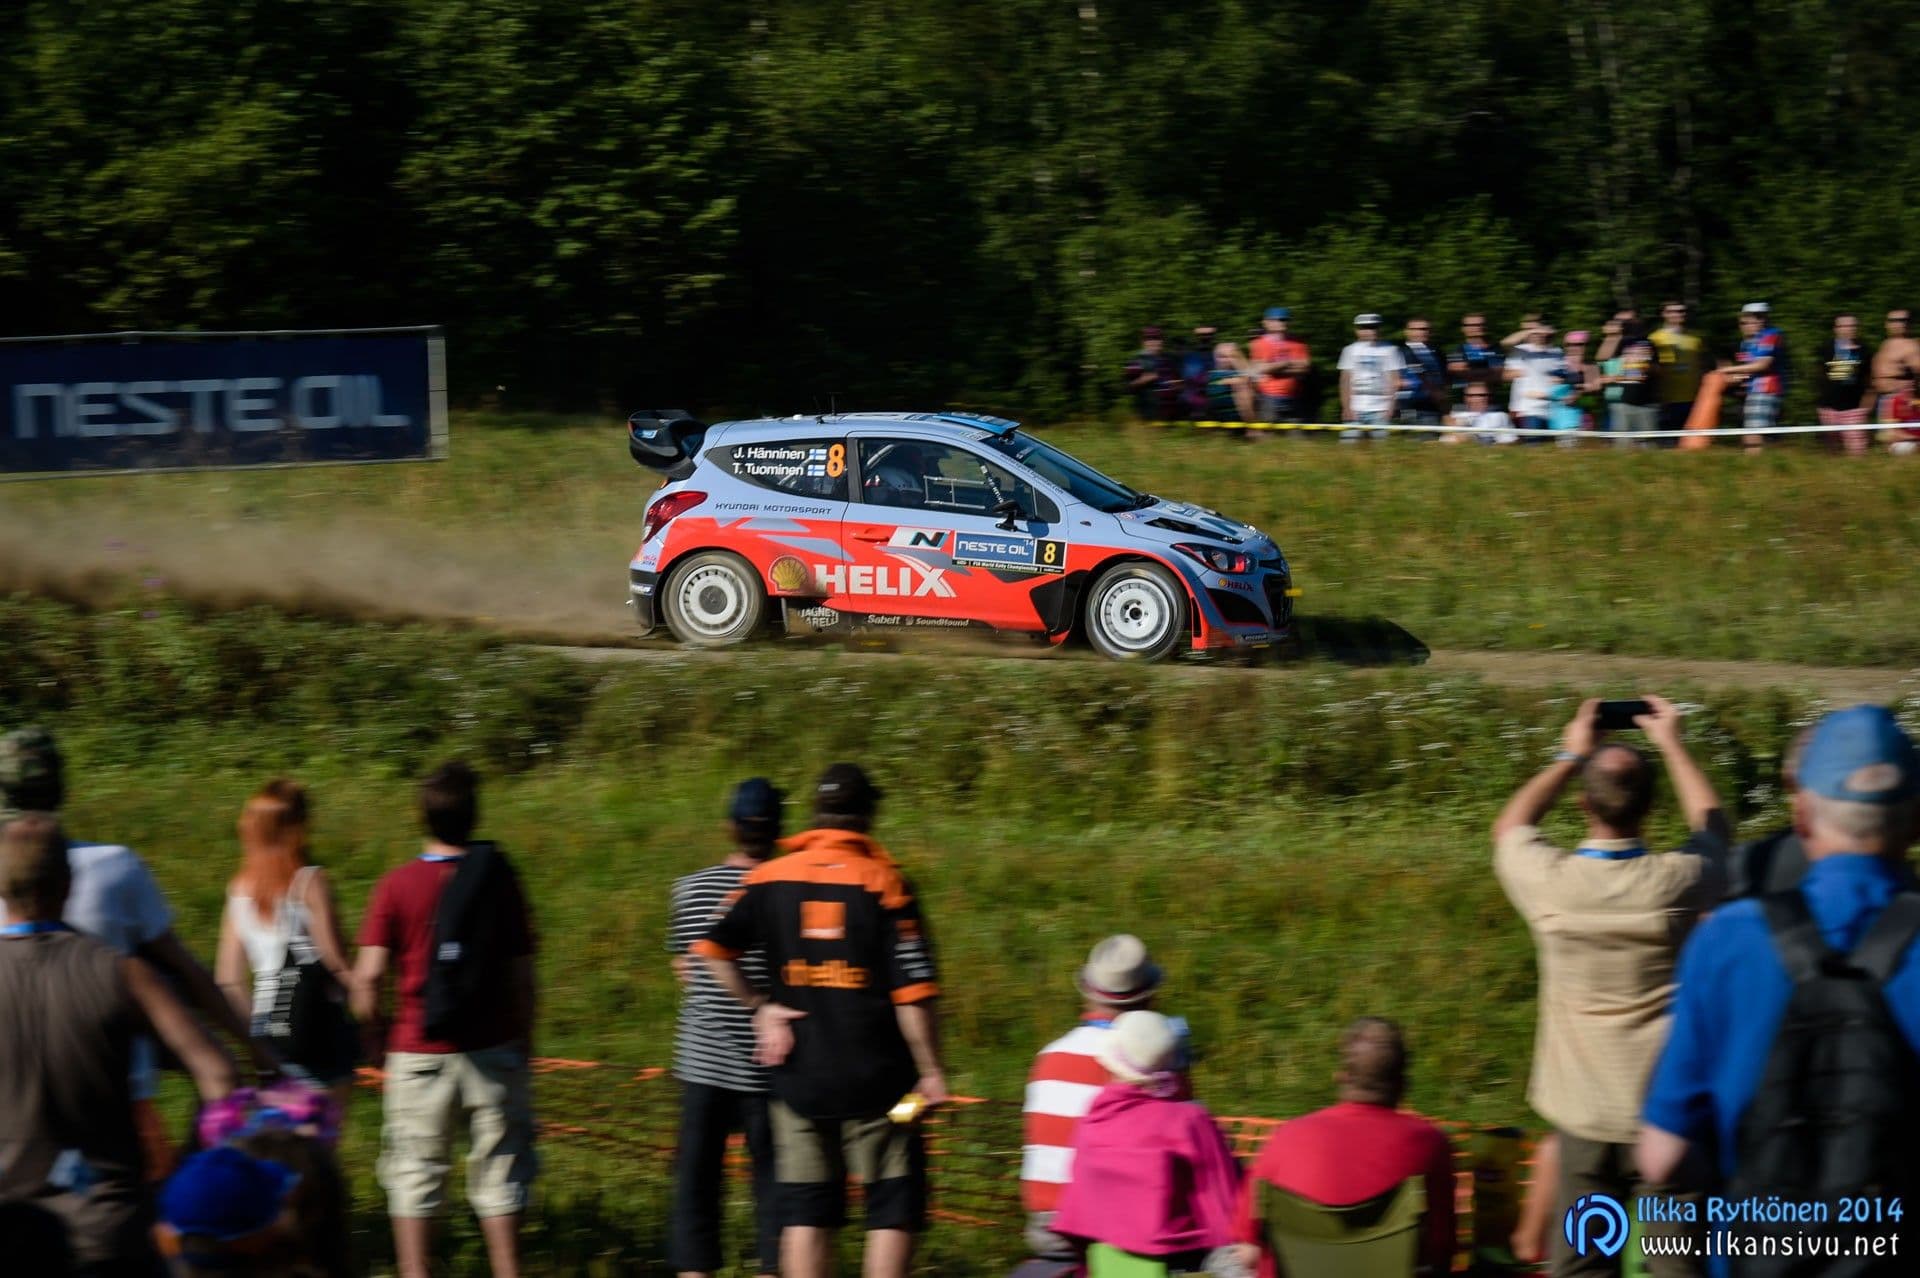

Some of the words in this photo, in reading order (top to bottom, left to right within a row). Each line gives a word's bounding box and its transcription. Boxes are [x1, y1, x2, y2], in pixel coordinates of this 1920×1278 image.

[14, 377, 283, 439] NESTE
[293, 375, 410, 429] OIL
[733, 447, 745, 459] J.
[747, 447, 805, 460] Hänninen
[826, 443, 846, 478] 8
[732, 462, 743, 475] T.
[745, 463, 804, 476] Tuominen
[715, 503, 759, 511] HYUNDAI
[763, 505, 832, 515] MOTORSPORT
[958, 541, 1006, 554] NESTE
[1008, 545, 1029, 556] OIL
[1043, 542, 1056, 564] 8
[814, 554, 957, 598] HELIX
[868, 614, 900, 625] Sabelt
[916, 617, 969, 626] SoundHound
